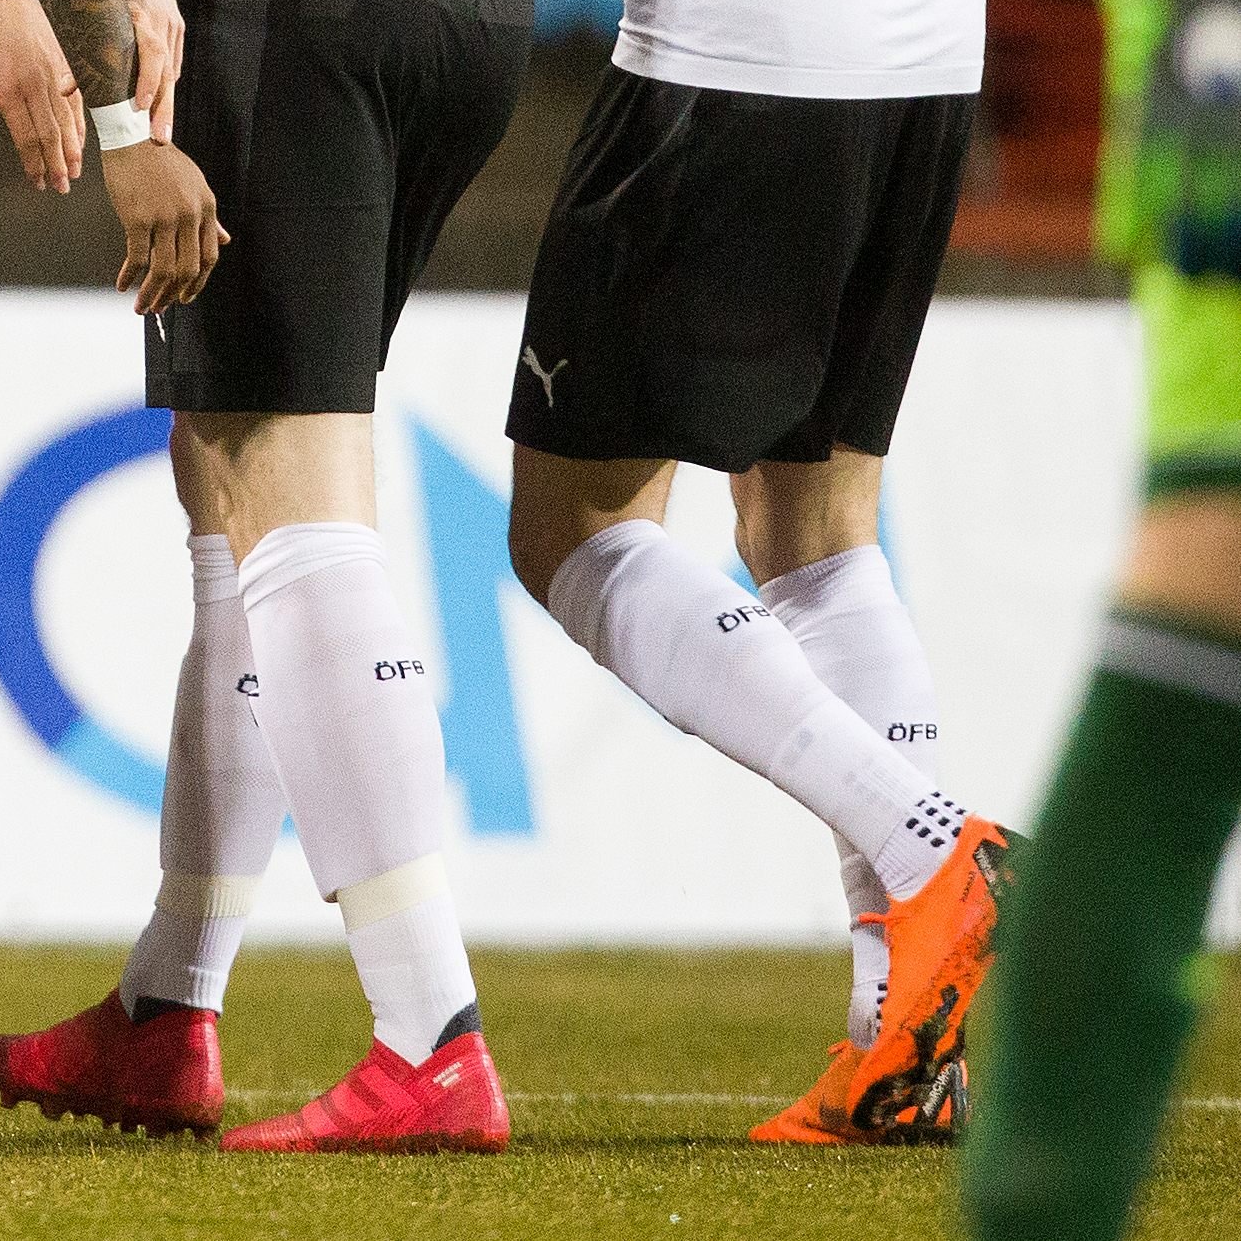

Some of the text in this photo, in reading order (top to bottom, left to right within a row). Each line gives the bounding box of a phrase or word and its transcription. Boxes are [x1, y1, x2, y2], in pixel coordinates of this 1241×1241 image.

[716, 605, 771, 633] ÖFB
[374, 660, 425, 681] ÖFB
[887, 722, 938, 742] ÖFB
